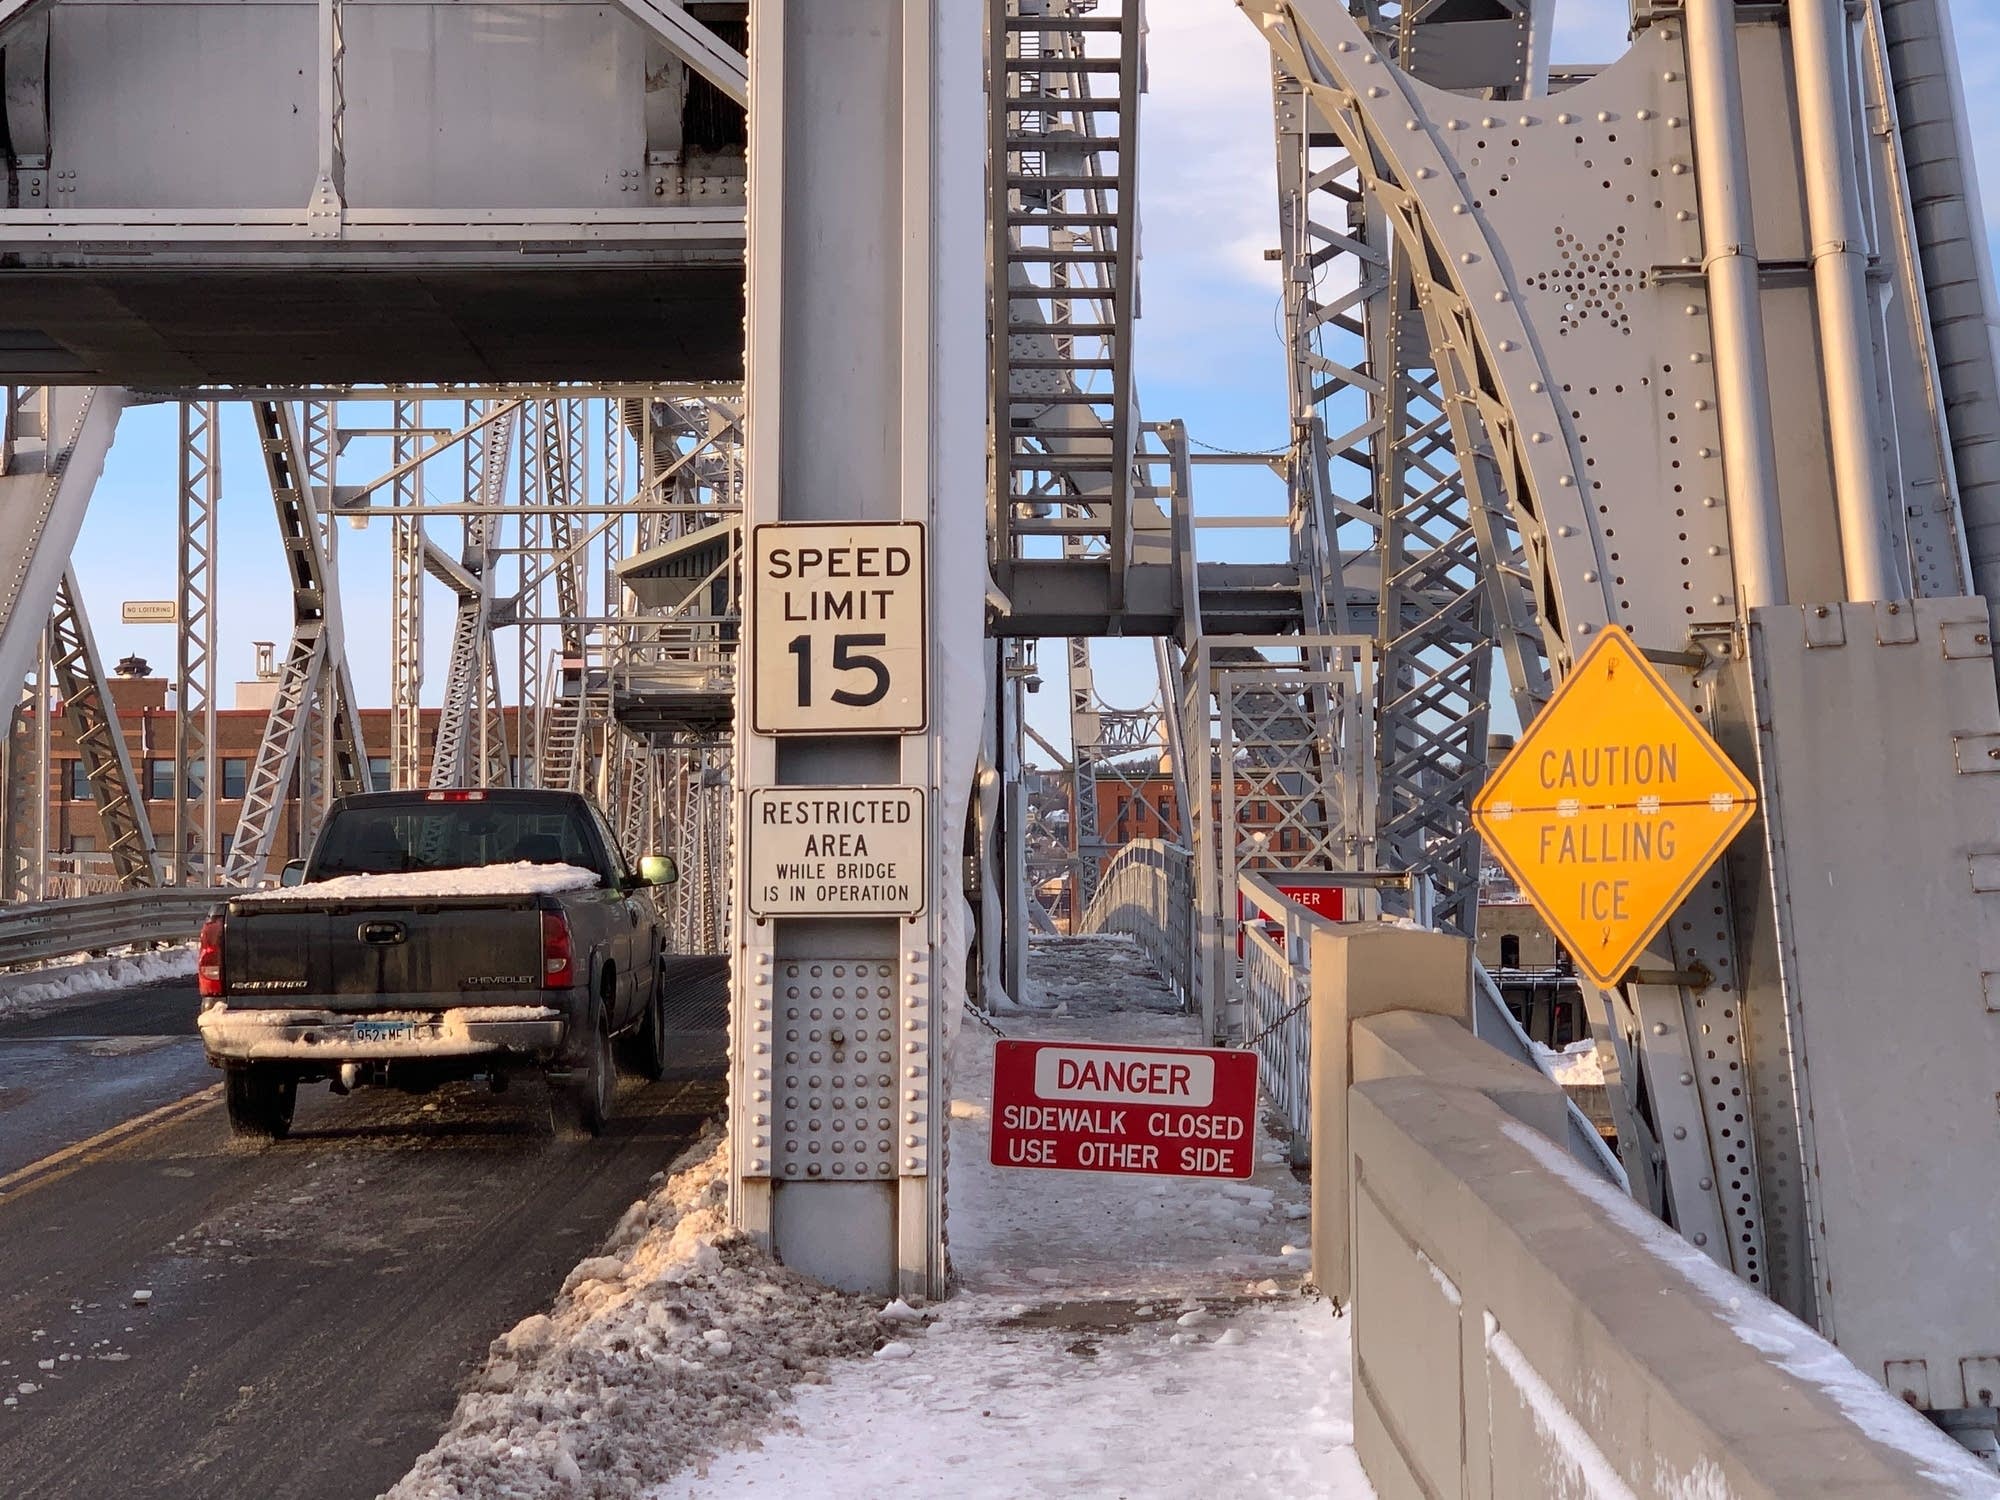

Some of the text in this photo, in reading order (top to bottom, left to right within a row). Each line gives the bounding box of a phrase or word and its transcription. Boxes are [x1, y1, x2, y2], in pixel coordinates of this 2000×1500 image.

[768, 547, 911, 578] SPEED
[784, 590, 895, 622] LIMIT
[788, 632, 891, 708] 15
[1539, 743, 1679, 790] CAUTION
[762, 800, 911, 825] RESTRICTED
[804, 833, 869, 857] AREA
[1539, 820, 1676, 865] FALLING
[775, 862, 897, 880] WHILE BRIDGE
[763, 884, 909, 902] IS IN OPERATION
[1580, 880, 1630, 921] ICE
[468, 976, 535, 984] CHEVROLET
[357, 1028, 380, 1042] 952
[1057, 1058, 1191, 1096] DANGER
[1003, 1105, 1244, 1141] SIDEWALK CLOSED
[1008, 1138, 1235, 1174] USE OTHER SIDE
